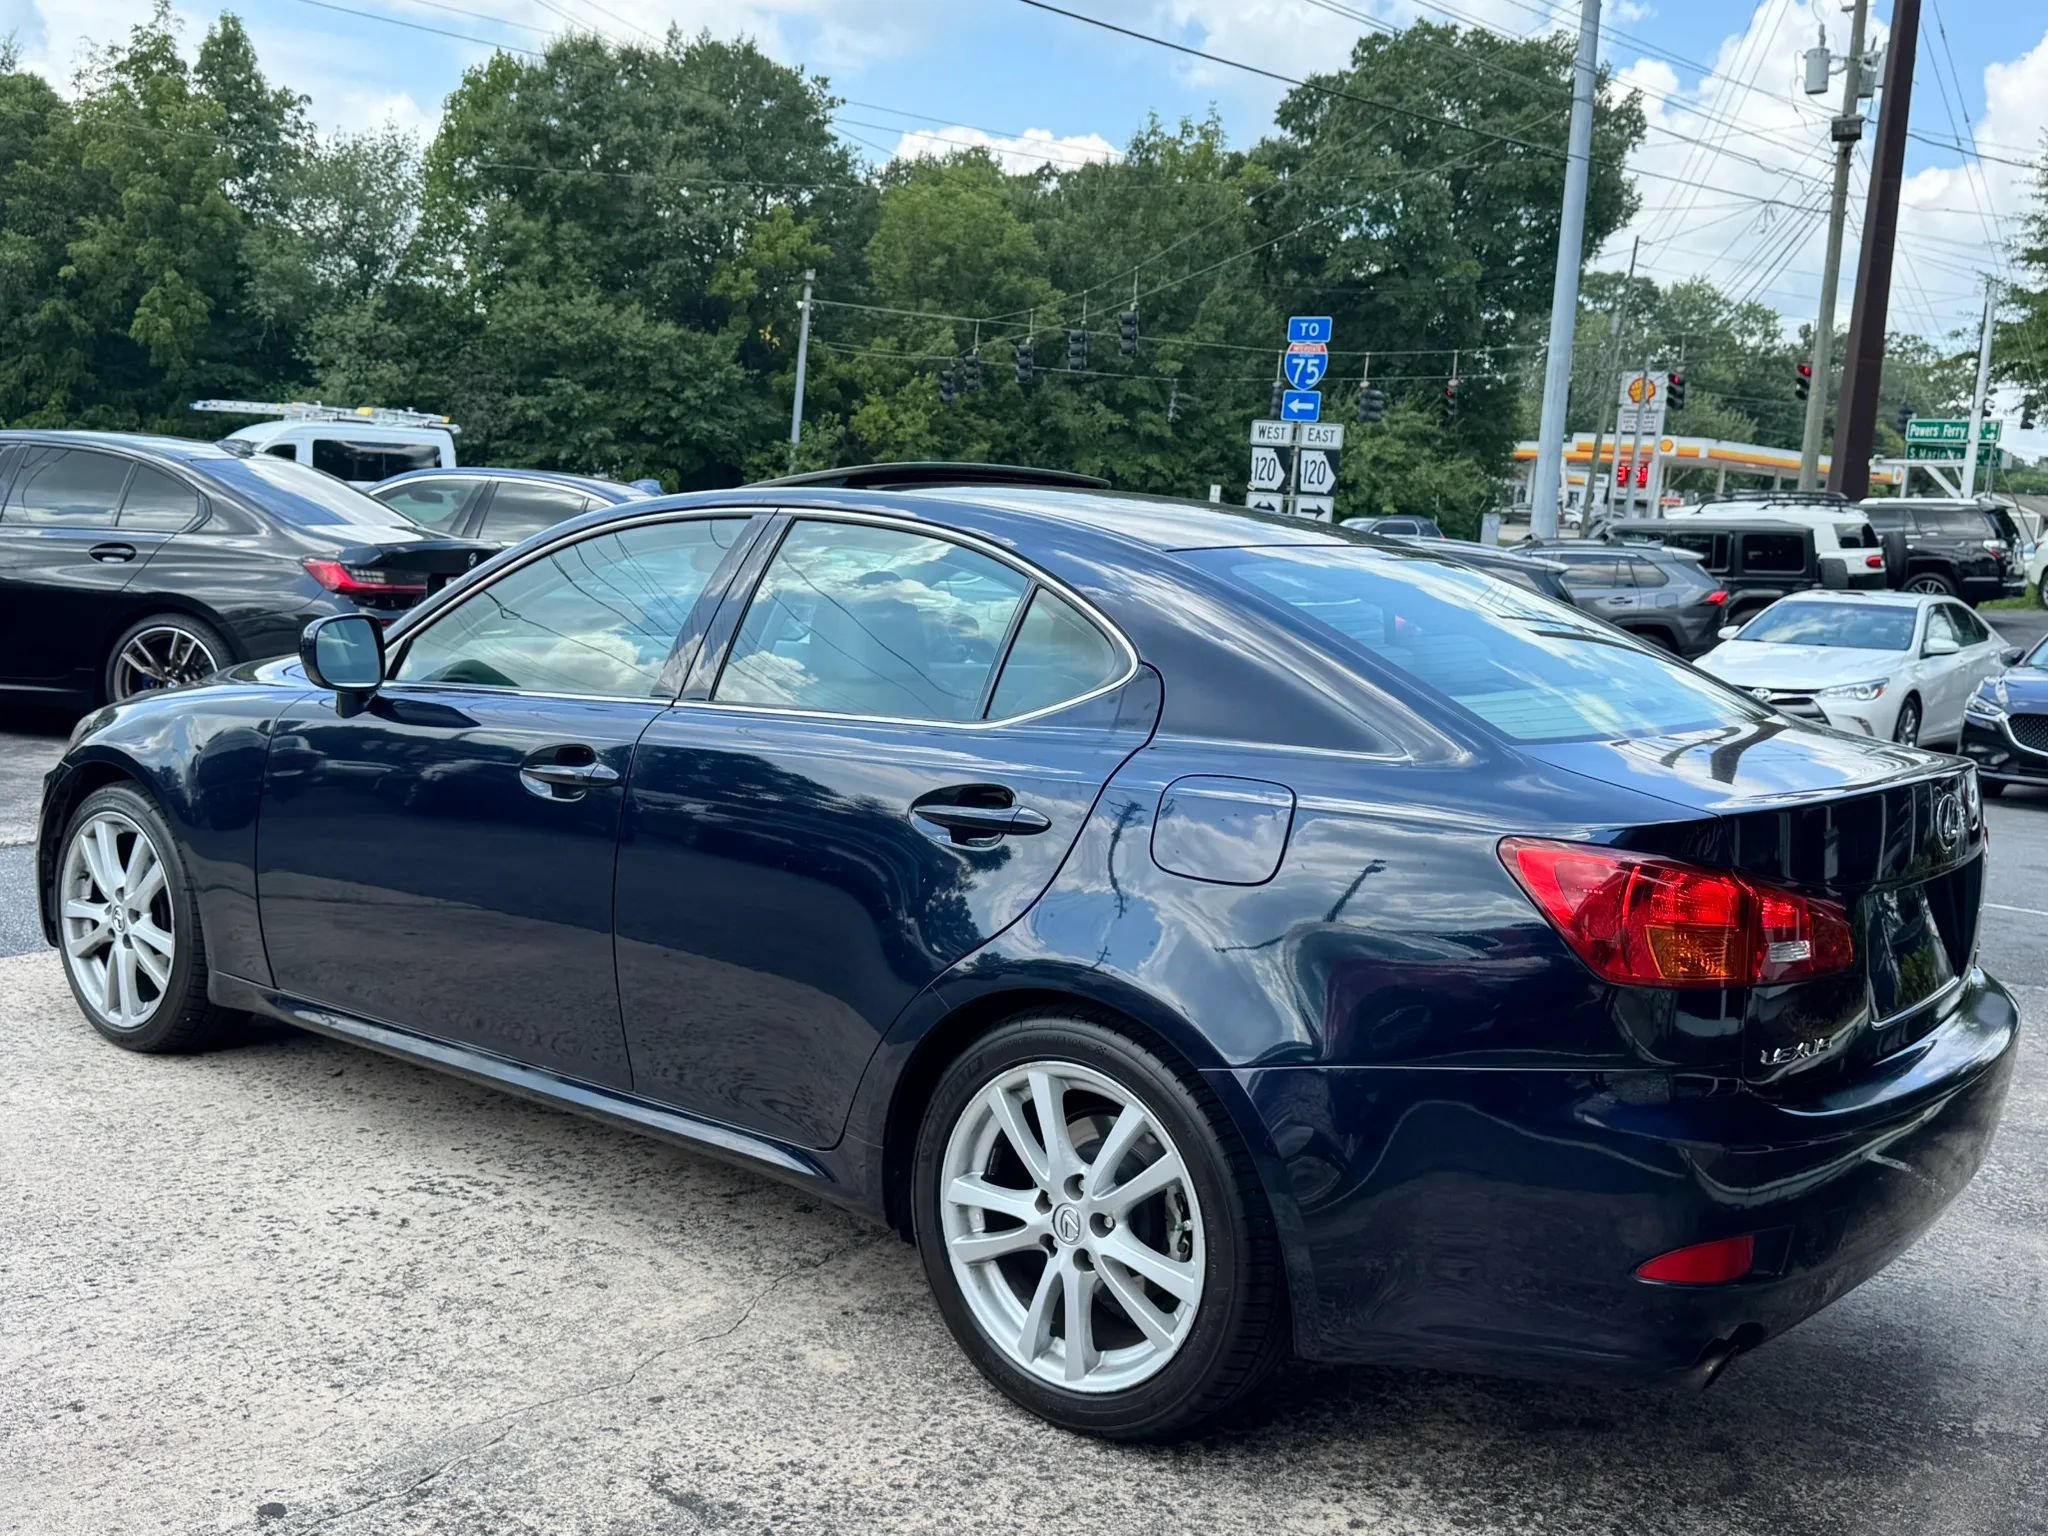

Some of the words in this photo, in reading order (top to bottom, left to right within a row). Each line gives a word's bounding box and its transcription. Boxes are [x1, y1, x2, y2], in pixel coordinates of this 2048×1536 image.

[1300, 322, 1320, 337] TO
[1292, 358, 1320, 385] 75
[1258, 425, 1287, 440] WEST
[1307, 427, 1336, 443] EAST
[1909, 423, 1939, 438] Powers
[1943, 423, 1967, 440] Ferry
[1254, 456, 1277, 482] 120
[1303, 459, 1327, 486] 120
[1760, 1038, 1832, 1066] LEXUS
